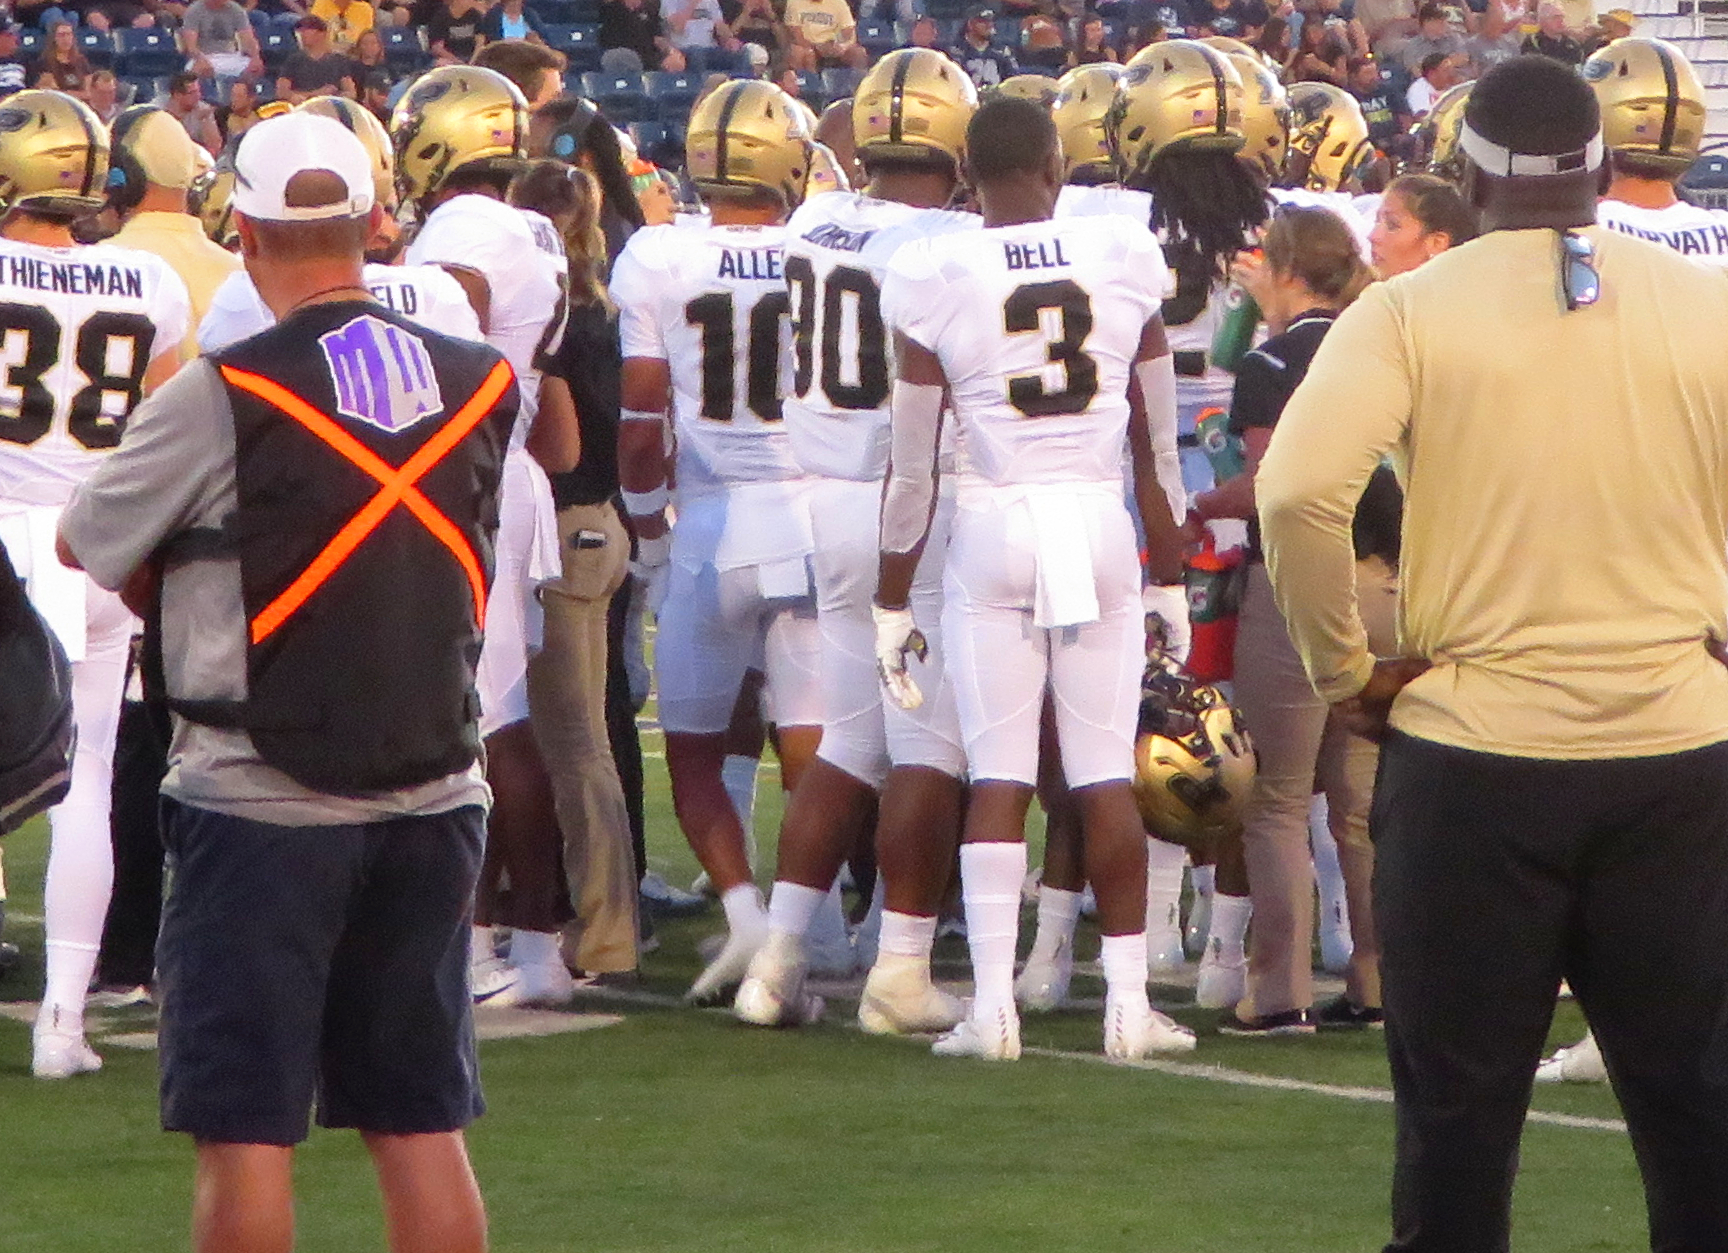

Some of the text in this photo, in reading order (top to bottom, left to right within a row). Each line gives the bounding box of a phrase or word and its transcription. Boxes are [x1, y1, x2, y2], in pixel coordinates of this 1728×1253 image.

[718, 248, 785, 280] ALLE
[1004, 237, 1071, 271] BELL
[684, 290, 785, 423] 10
[1003, 277, 1102, 420] 3
